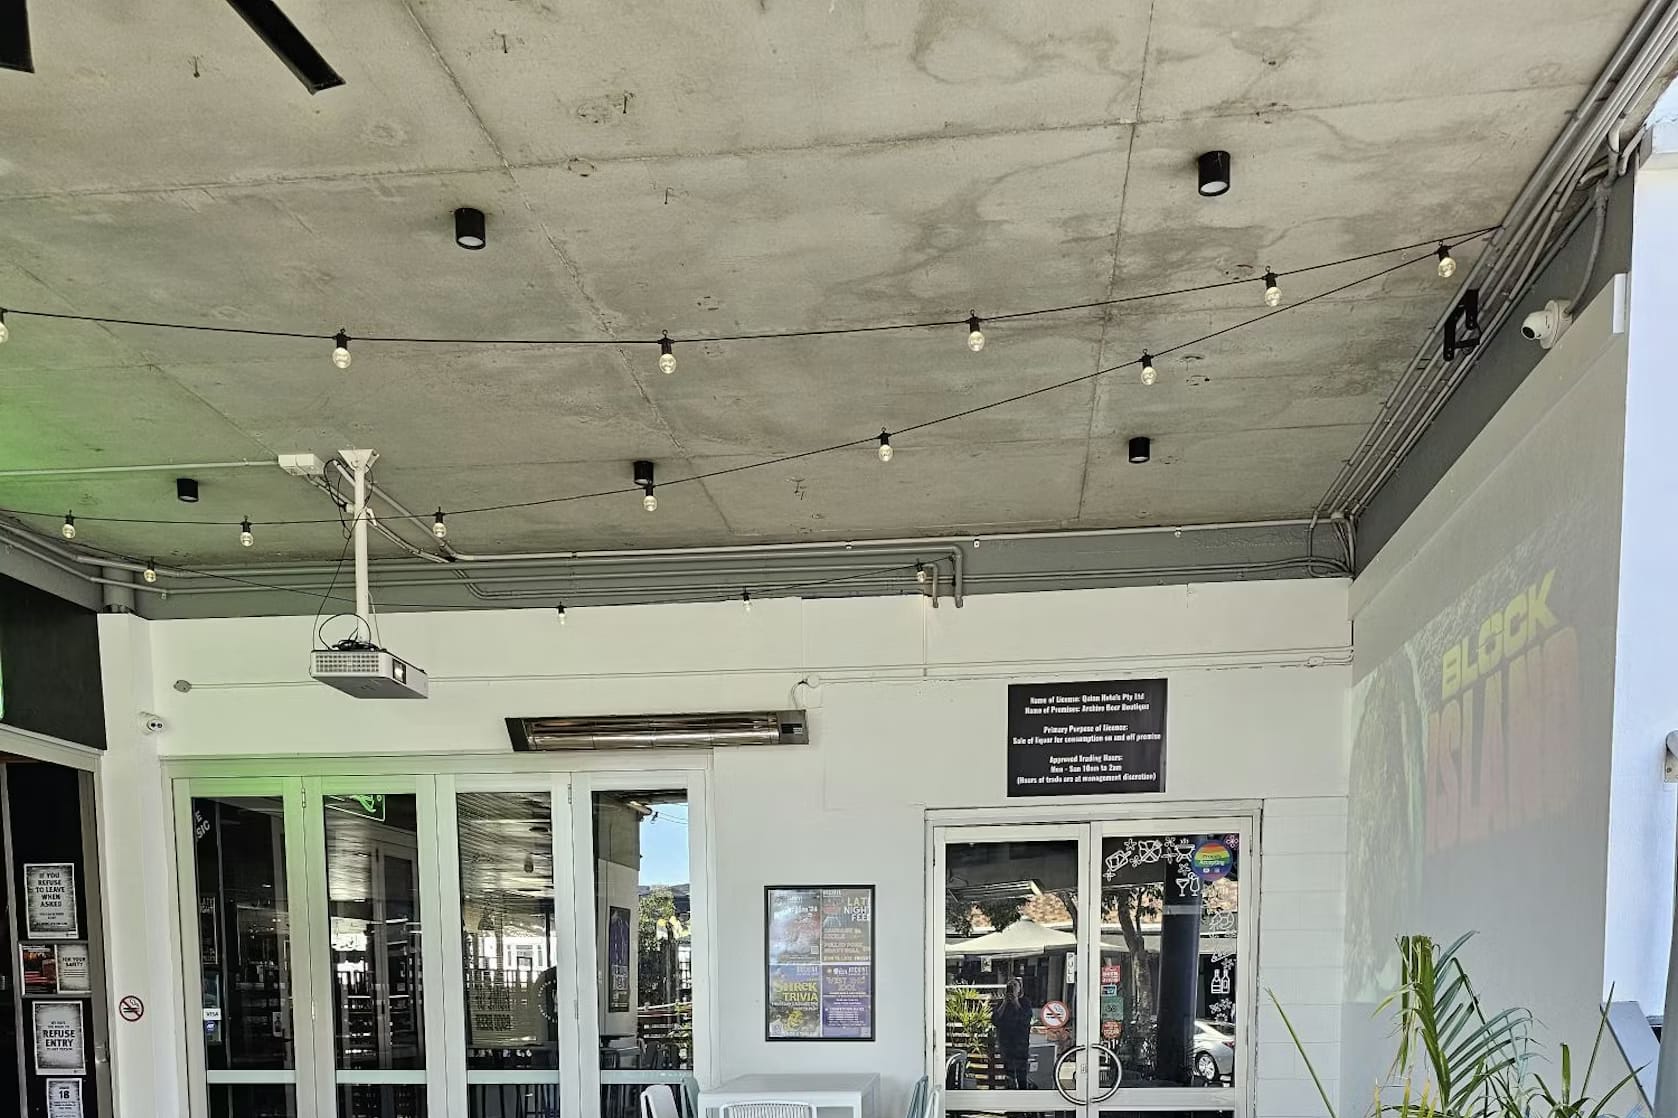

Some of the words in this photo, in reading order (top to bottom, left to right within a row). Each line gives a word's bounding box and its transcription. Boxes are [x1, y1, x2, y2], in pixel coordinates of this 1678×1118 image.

[1442, 567, 1559, 700] BLOCK
[1048, 696, 1055, 704] of
[1101, 693, 1121, 702] Hotels
[1122, 693, 1133, 702] Pty
[1134, 692, 1145, 700] Ltd
[1043, 706, 1050, 714] of
[1121, 703, 1150, 711] Boutique
[1043, 726, 1068, 735] Primary
[1069, 725, 1094, 733] Purpose
[1095, 724, 1102, 732] of
[1012, 737, 1026, 745] Sale
[1035, 736, 1053, 745] liquor
[1064, 734, 1104, 744] consumption
[1113, 733, 1125, 741] and
[1126, 732, 1136, 741] off
[1049, 755, 1078, 764] Approved
[1079, 753, 1102, 763] Trading
[1103, 753, 1124, 762] Hours:
[1050, 765, 1063, 773] Mon
[1069, 765, 1081, 773] Sun
[1082, 764, 1100, 772] 10am
[1108, 763, 1122, 771] 2am
[1017, 776, 1037, 785] (Hours
[1038, 776, 1045, 784] of
[1046, 775, 1062, 783] trade
[1074, 775, 1082, 783] at
[1082, 774, 1122, 782] management
[1122, 772, 1157, 781] discretion)
[847, 897, 871, 906] LAT
[844, 906, 871, 914] NIGH
[782, 992, 818, 1002] TRIVIA
[42, 1029, 76, 1038] REFUSE
[45, 1039, 74, 1047] ENTRY
[59, 1090, 70, 1099] 18
